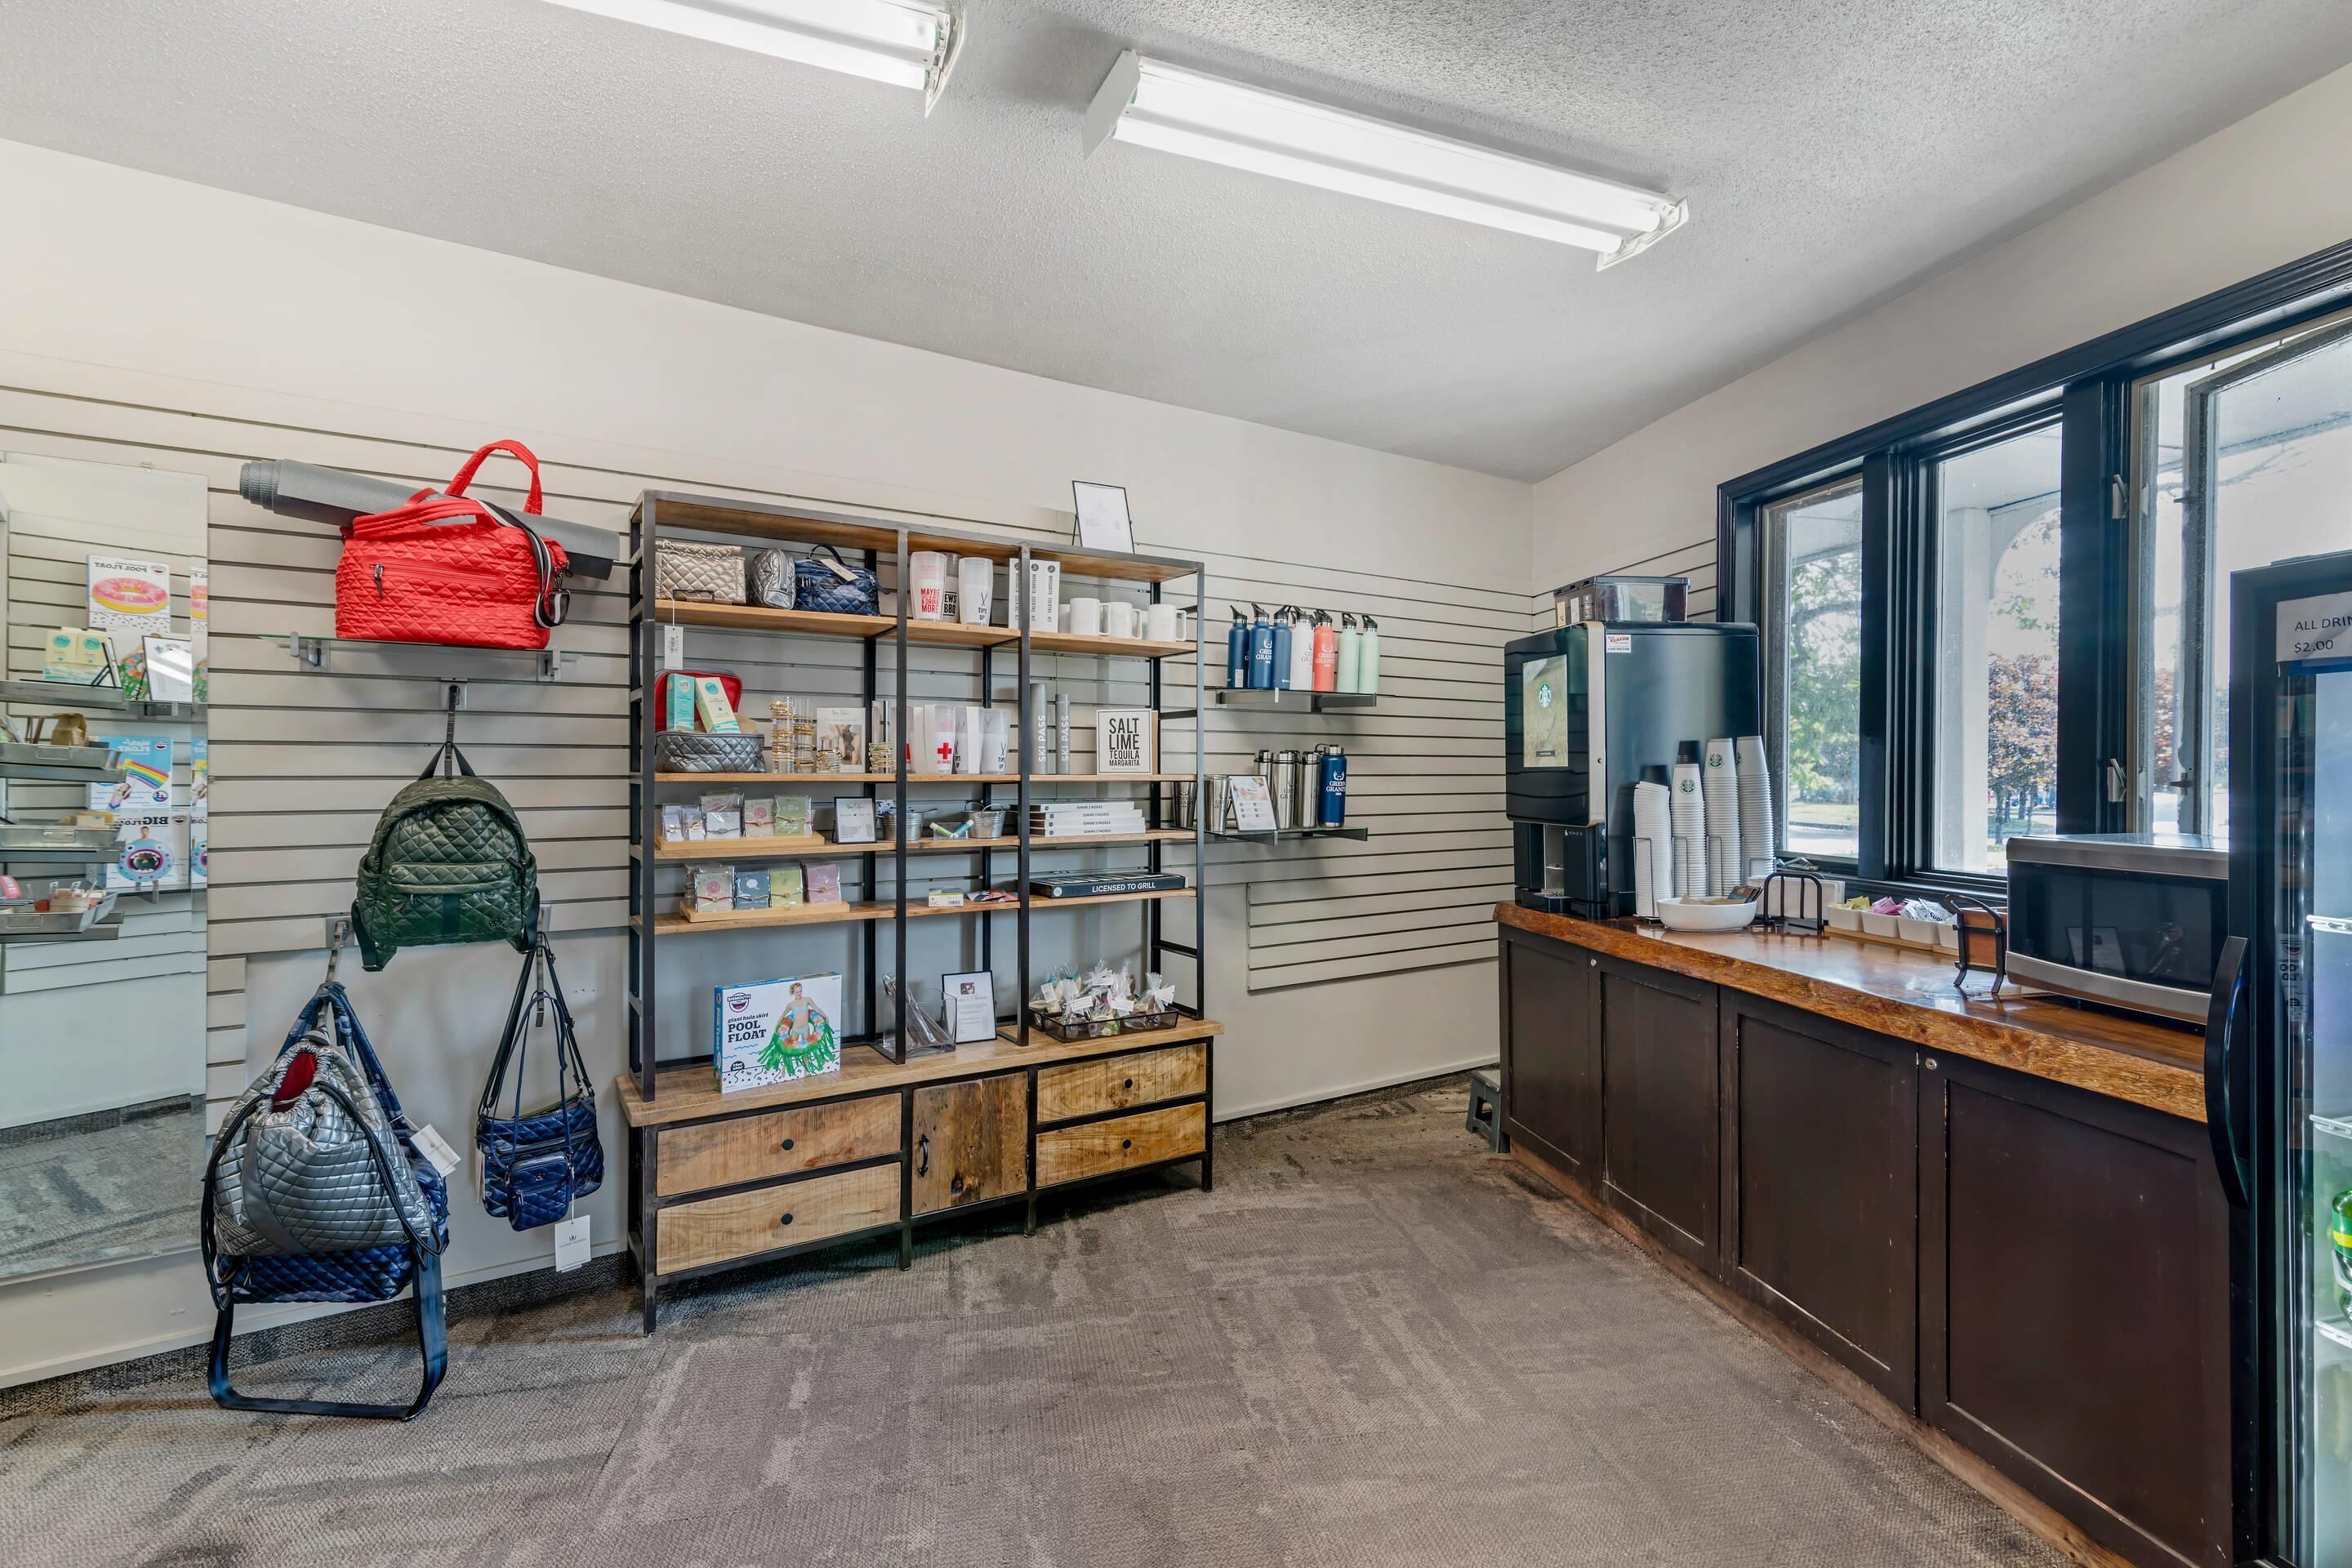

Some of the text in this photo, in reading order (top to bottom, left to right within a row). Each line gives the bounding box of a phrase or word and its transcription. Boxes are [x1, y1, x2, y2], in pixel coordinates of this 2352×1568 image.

[920, 588, 940, 596] MAYBE
[921, 604, 939, 614] MORE
[944, 604, 956, 614] BBQ
[2295, 620, 2318, 631] ALL
[2294, 639, 2334, 653] $2.00
[1109, 718, 1139, 734] SALT
[1038, 715, 1046, 762] SKI PASS
[1062, 715, 1070, 762] SKI PASS
[1109, 734, 1139, 750] LIME
[1109, 750, 1140, 760] TEQUILA
[1092, 884, 1125, 893] LICENSED
[728, 1016, 742, 1024] giant
[728, 1020, 760, 1033] POOL
[728, 1029, 767, 1043] FLOAT
